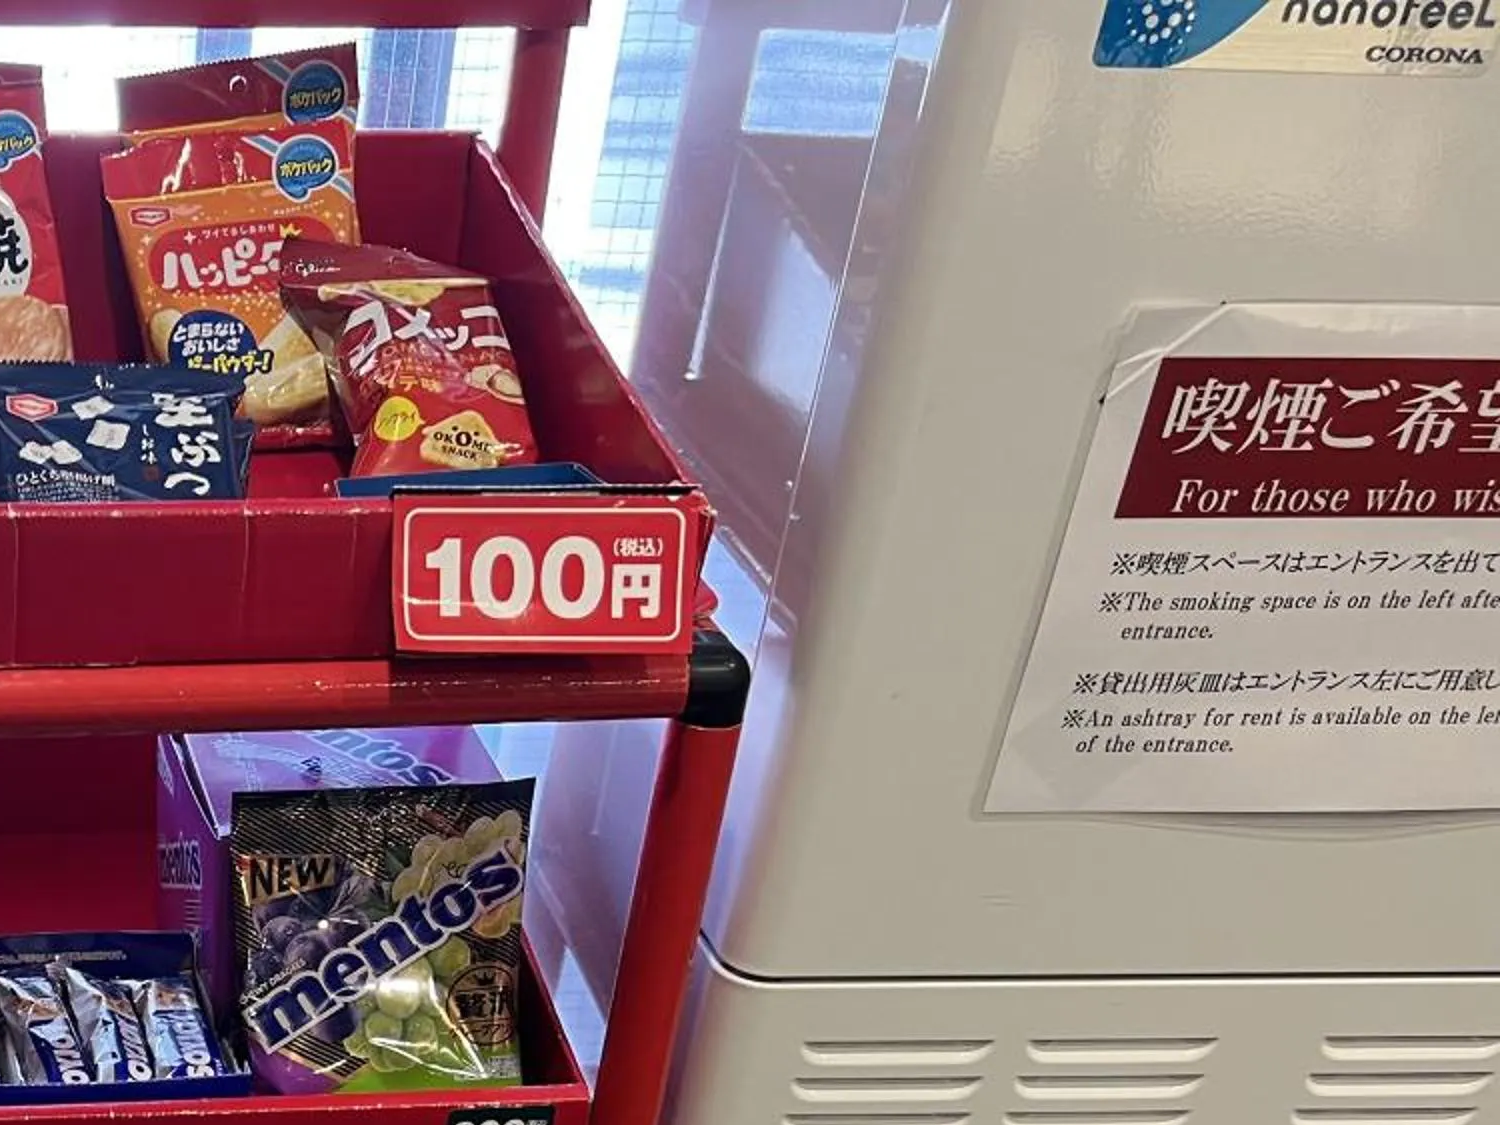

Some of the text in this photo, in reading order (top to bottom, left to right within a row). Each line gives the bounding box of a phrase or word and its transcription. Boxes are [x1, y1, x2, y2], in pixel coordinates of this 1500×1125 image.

[1365, 46, 1484, 64] CORONA
[279, 157, 333, 178] ポケパック
[172, 322, 245, 342] とまらない
[181, 338, 241, 357] おいしさ
[1171, 479, 1239, 513] For
[1251, 479, 1349, 513] those
[1366, 479, 1437, 513] who
[1170, 591, 1254, 613] smoking
[1260, 594, 1317, 614] space
[1323, 590, 1340, 609] is
[1347, 595, 1371, 609] on
[1380, 589, 1411, 609] the
[1418, 589, 1455, 609] left
[1120, 623, 1215, 641] entrance.
[1121, 708, 1196, 729] ashtray
[1204, 707, 1235, 727] for
[1241, 707, 1282, 727] rent
[1288, 707, 1306, 726] is
[1312, 705, 1401, 725] available
[1408, 709, 1431, 725] on
[1439, 705, 1470, 725] the
[1075, 735, 1234, 753] of the entrance.
[251, 857, 332, 899] NEW
[243, 850, 523, 1054] mentos
